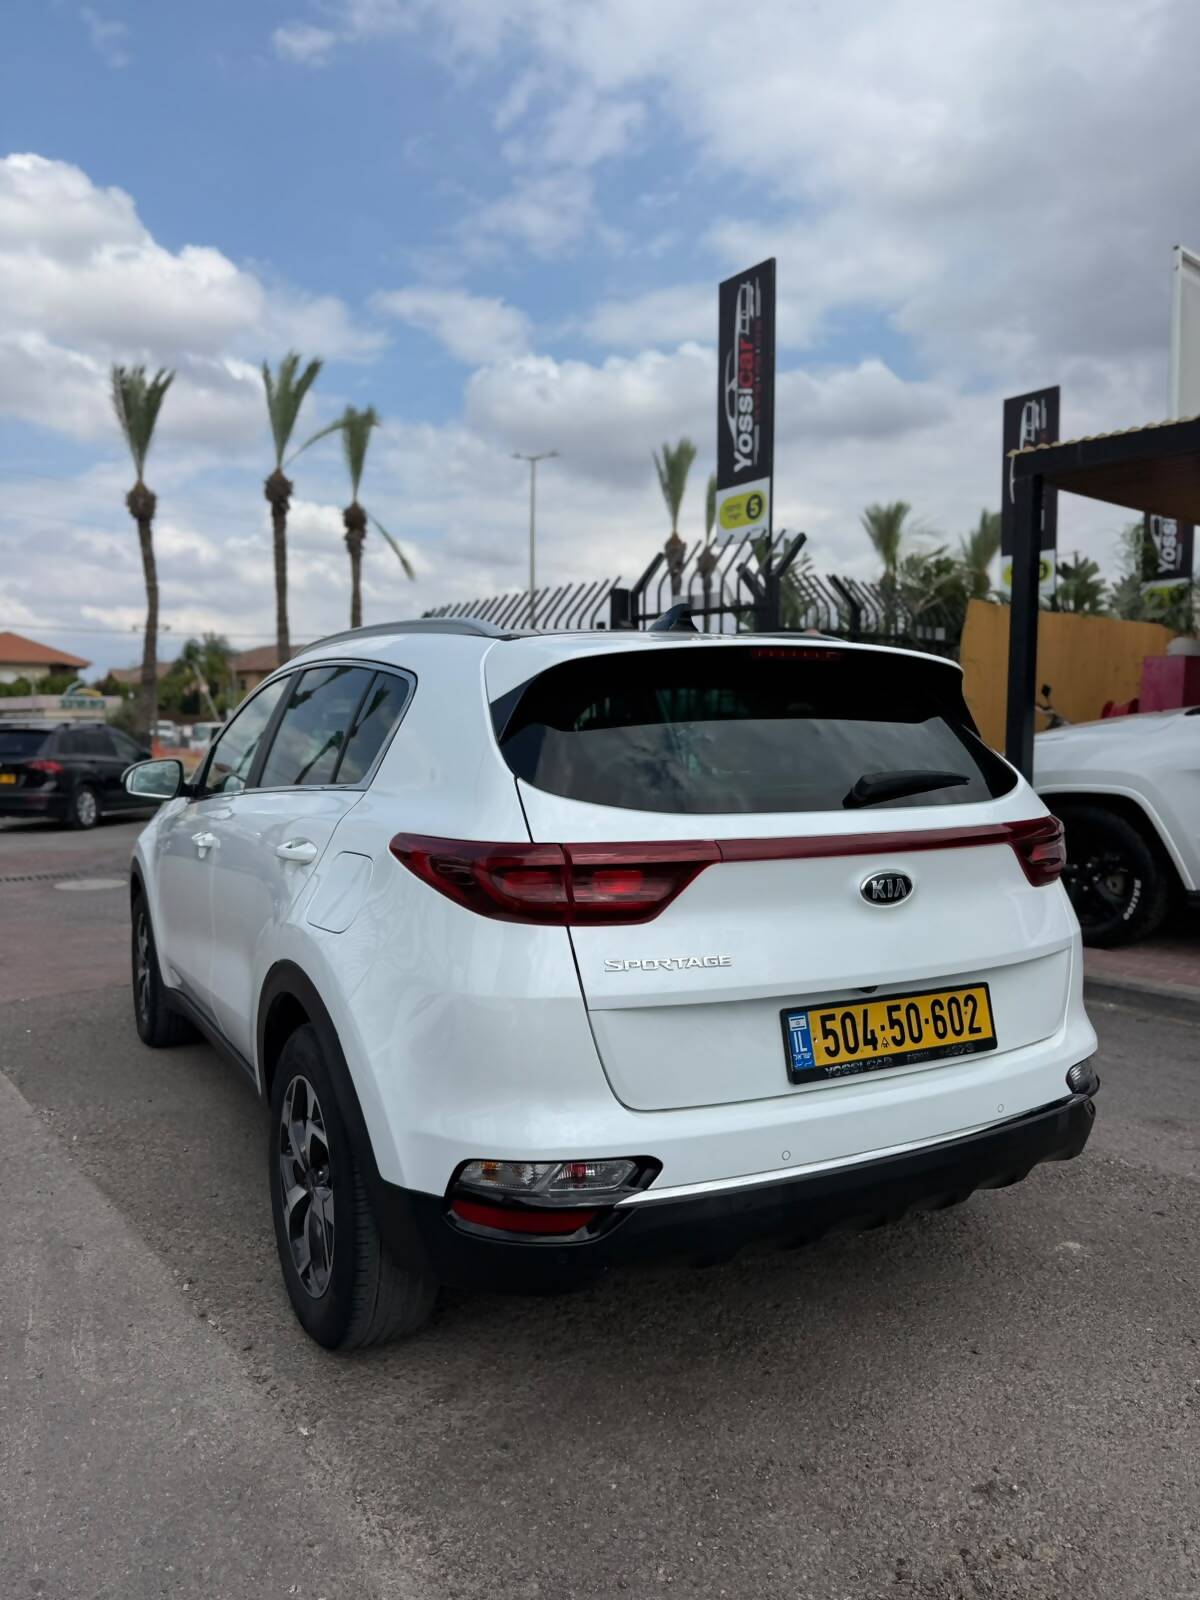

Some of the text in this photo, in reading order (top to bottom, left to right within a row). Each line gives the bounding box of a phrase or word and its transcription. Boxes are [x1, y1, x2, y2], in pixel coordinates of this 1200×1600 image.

[872, 878, 907, 900] KIA
[604, 955, 733, 972] SPORTAGE
[793, 1031, 808, 1053] IL
